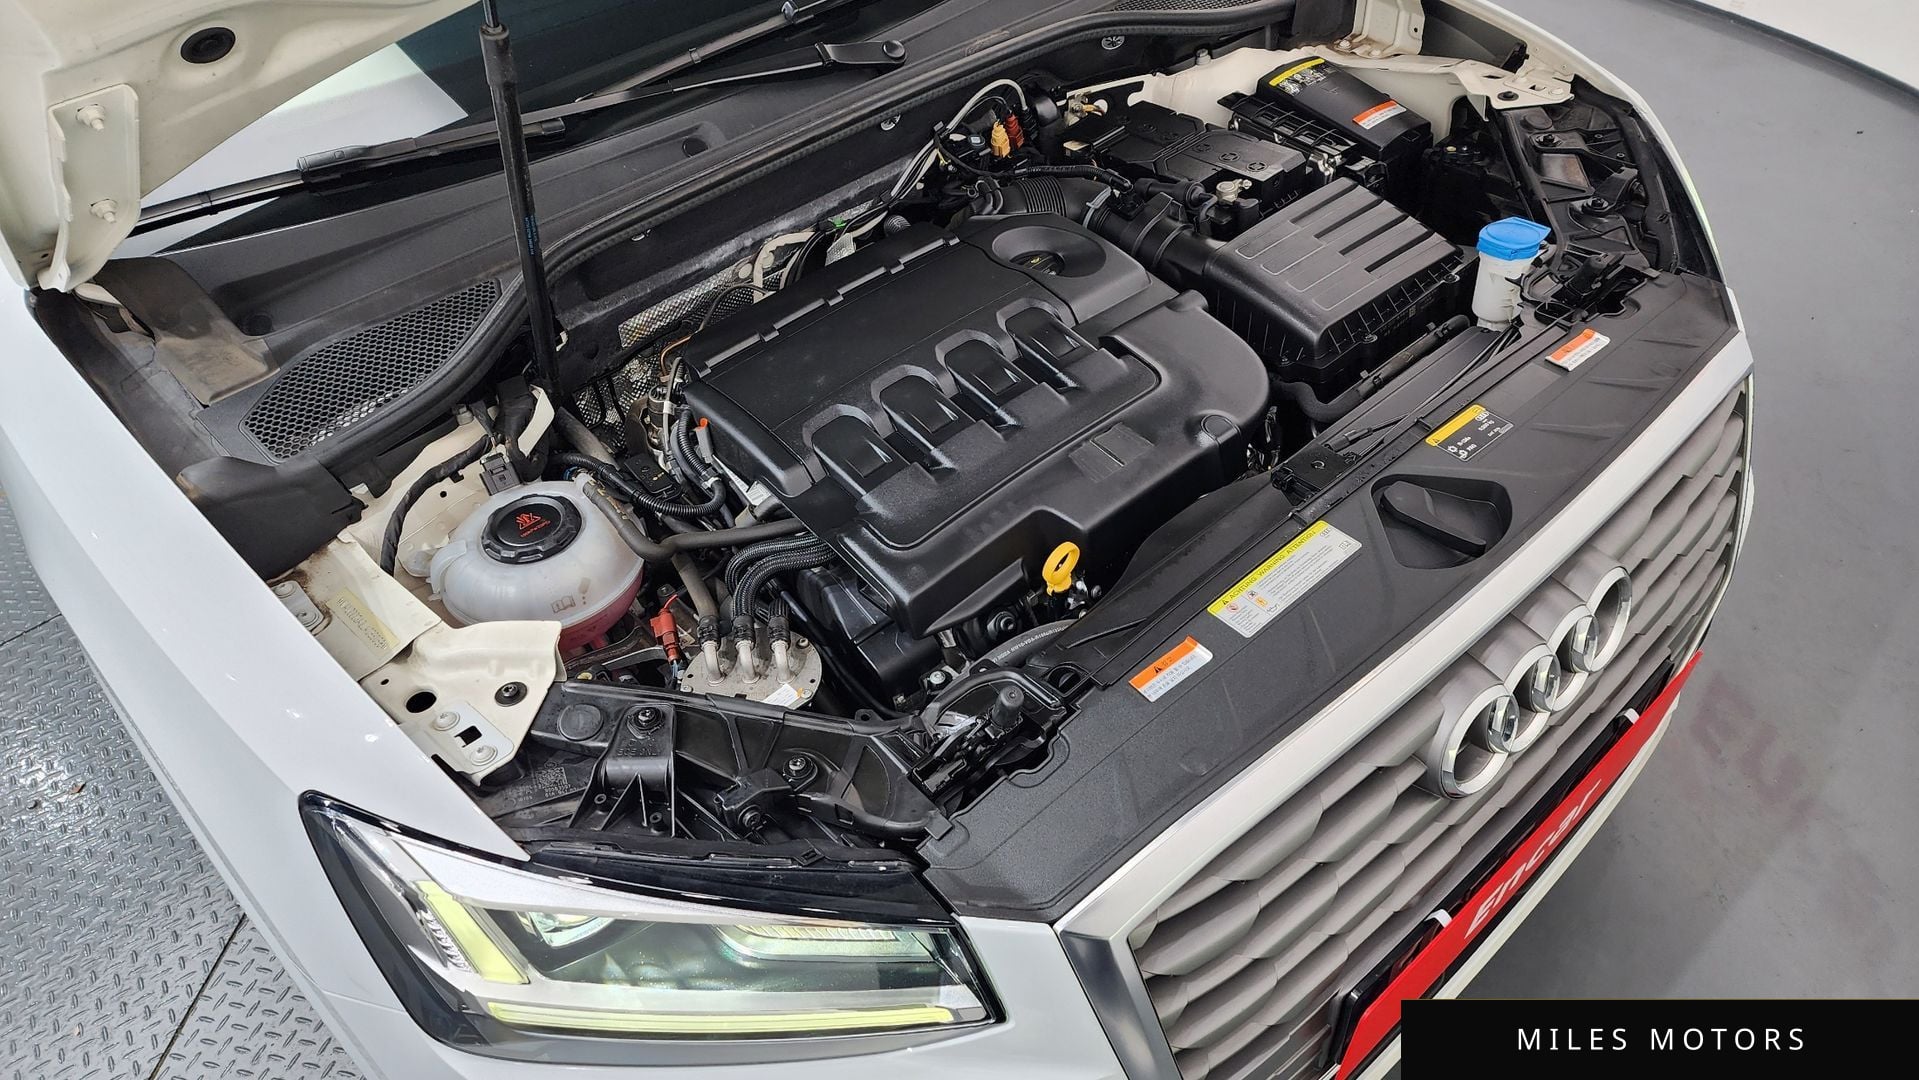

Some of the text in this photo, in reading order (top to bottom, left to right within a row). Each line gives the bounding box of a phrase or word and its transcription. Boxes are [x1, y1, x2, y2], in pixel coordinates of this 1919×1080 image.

[1229, 576, 1258, 600] ACHTUNG
[1258, 554, 1286, 577] WARNING
[1286, 530, 1317, 554] ATTENTION
[1464, 779, 1602, 939] Encar
